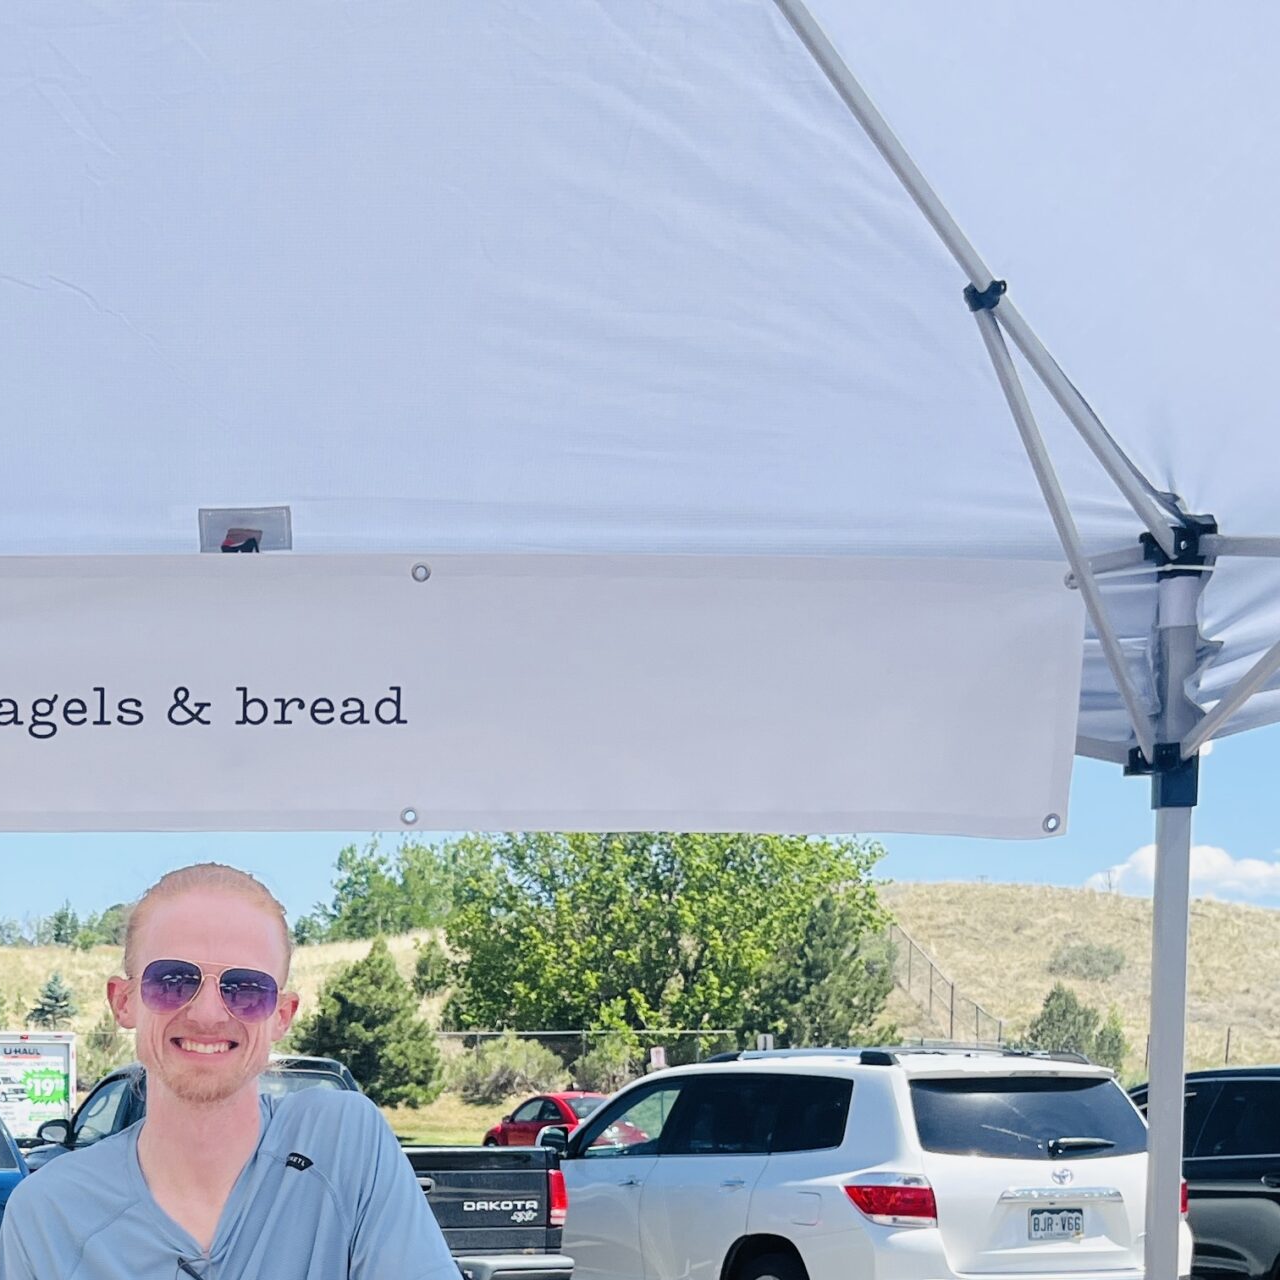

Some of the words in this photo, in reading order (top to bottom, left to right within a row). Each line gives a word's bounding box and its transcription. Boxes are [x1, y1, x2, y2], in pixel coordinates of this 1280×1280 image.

[167, 686, 211, 725] &
[235, 686, 409, 725] bread
[3, 1047, 41, 1056] U-HAUL
[463, 1200, 538, 1211] DAKOTA
